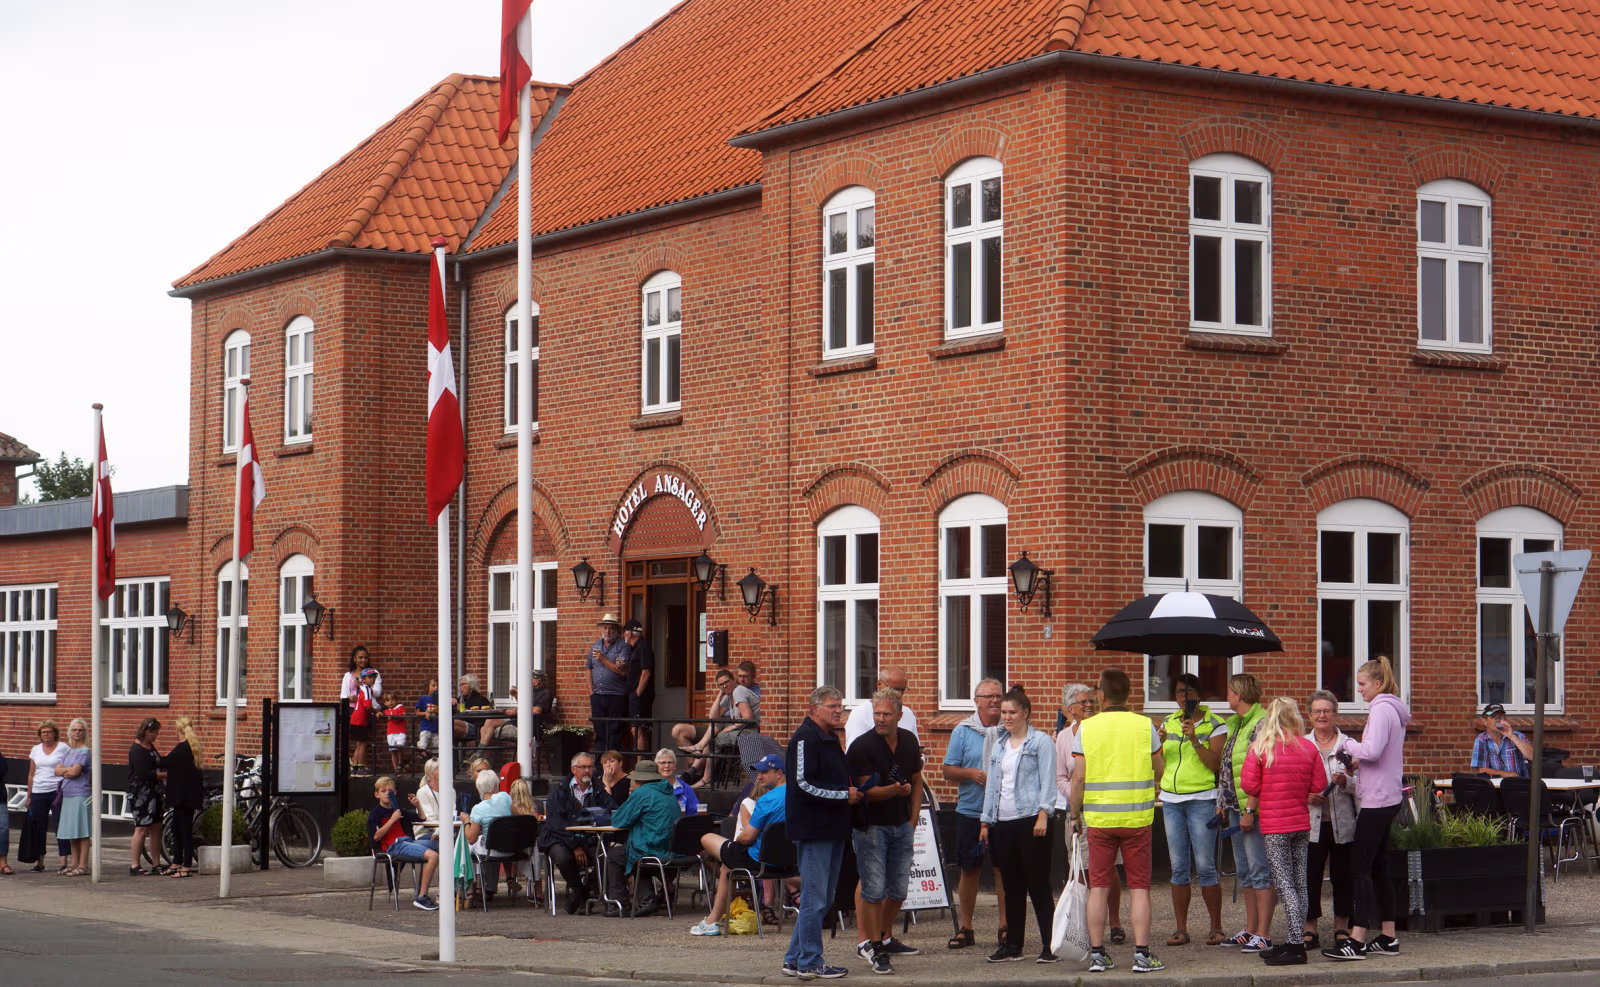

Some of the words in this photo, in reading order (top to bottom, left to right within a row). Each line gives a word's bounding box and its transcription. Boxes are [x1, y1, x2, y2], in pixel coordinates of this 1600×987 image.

[613, 482, 648, 538] HOTEL
[654, 473, 708, 532] ANSAGER
[1228, 625, 1265, 638] ProGolf
[920, 879, 942, 892] 99.-
